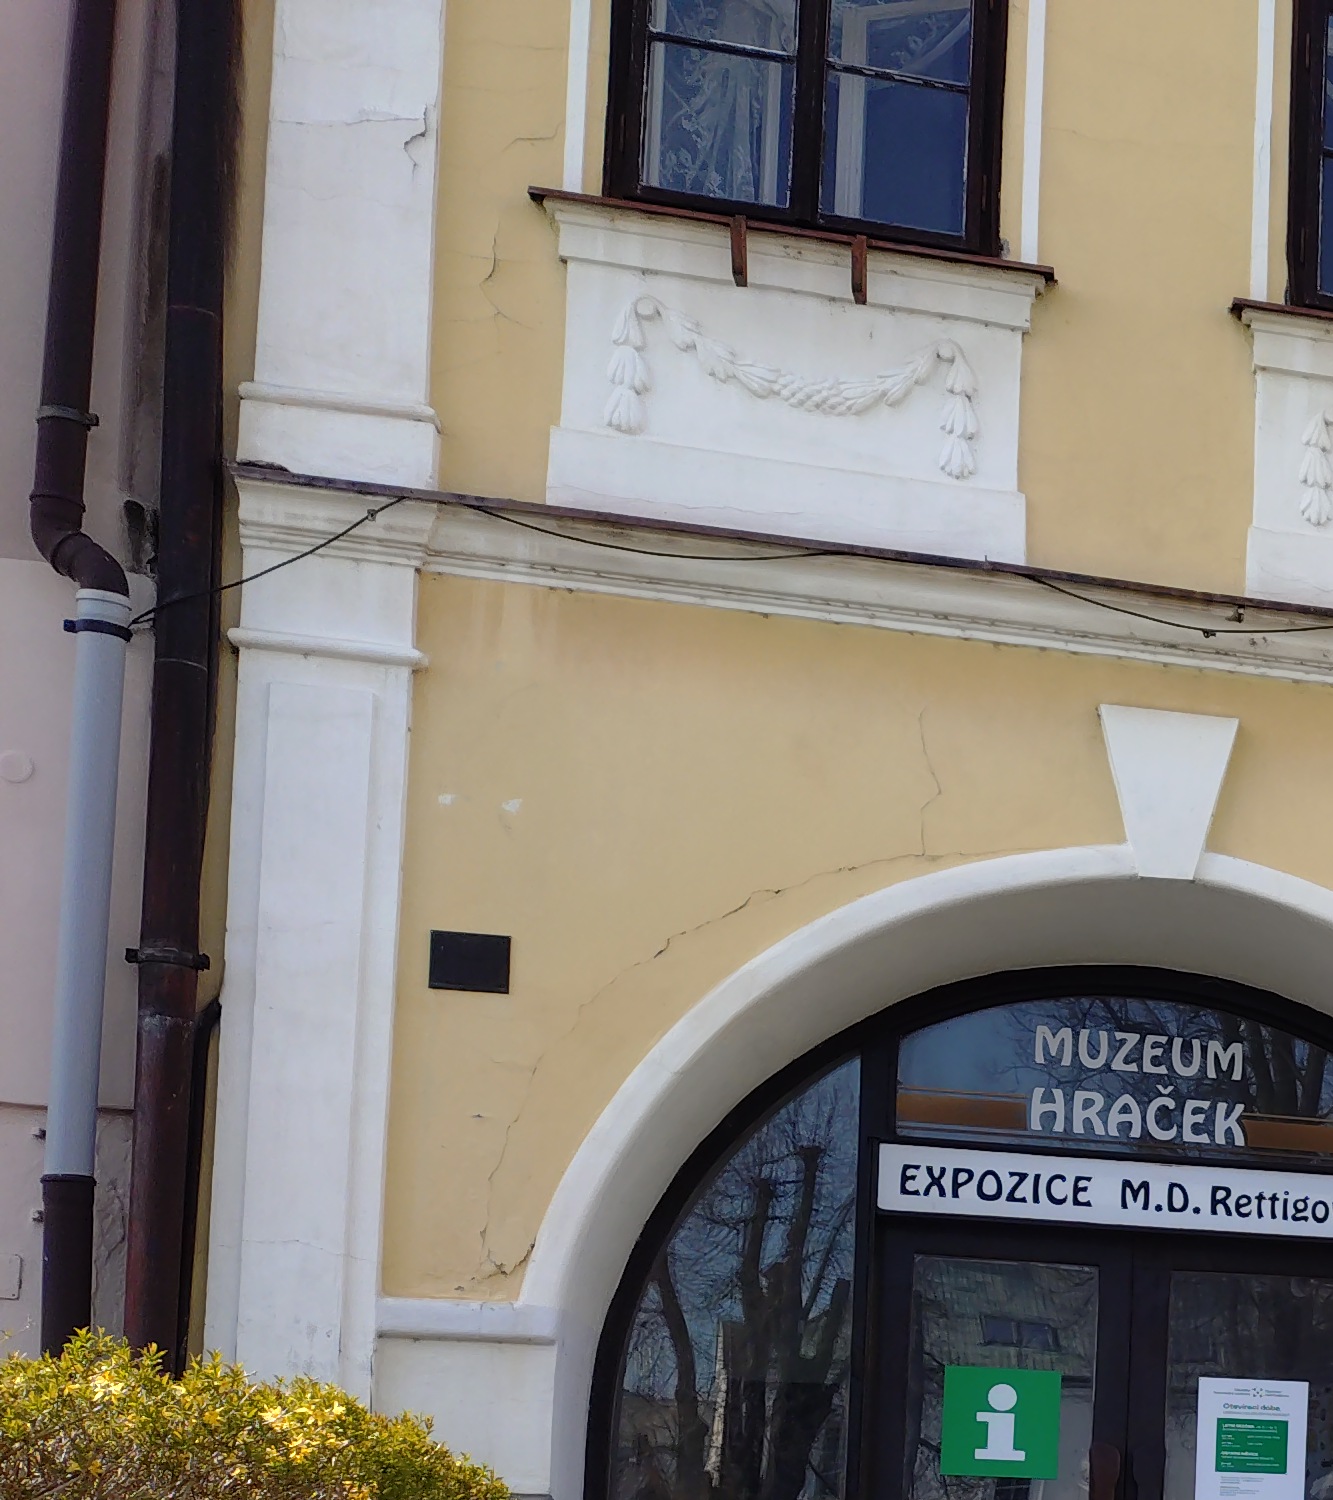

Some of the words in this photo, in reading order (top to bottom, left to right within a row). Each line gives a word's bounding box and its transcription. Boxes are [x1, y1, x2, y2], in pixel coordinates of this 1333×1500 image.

[1035, 1025, 1243, 1081] MUZEUM
[1031, 1084, 1245, 1147] HRAČEK
[900, 1164, 1093, 1207] EXPOZICE
